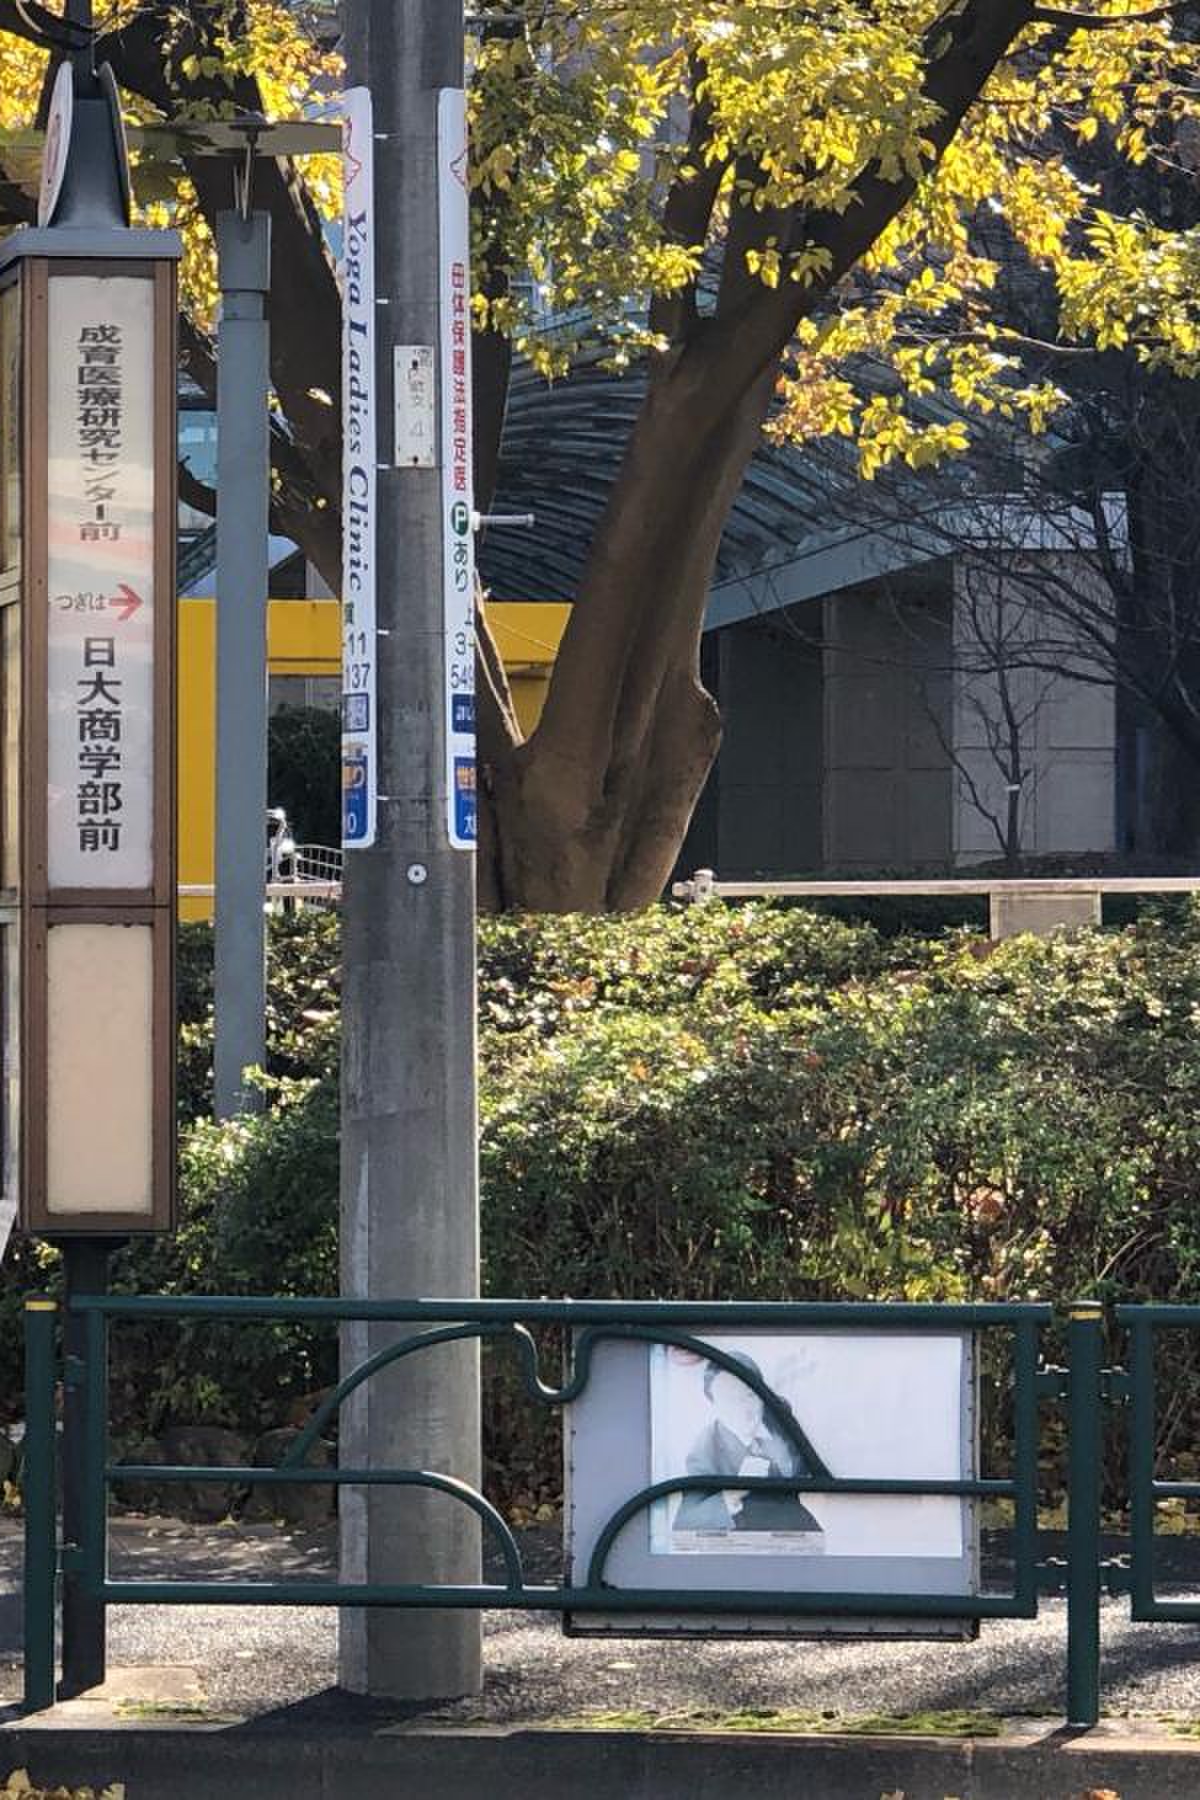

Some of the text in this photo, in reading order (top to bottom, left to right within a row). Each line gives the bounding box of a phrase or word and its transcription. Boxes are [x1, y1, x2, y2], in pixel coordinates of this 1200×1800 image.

[346, 209, 367, 306] Yoga
[78, 325, 123, 541] 成育医療研究センター前
[349, 319, 369, 454] Ladies
[349, 465, 369, 591] Clinic
[54, 591, 106, 612] つぎは
[77, 636, 122, 852] 日大商学部前
